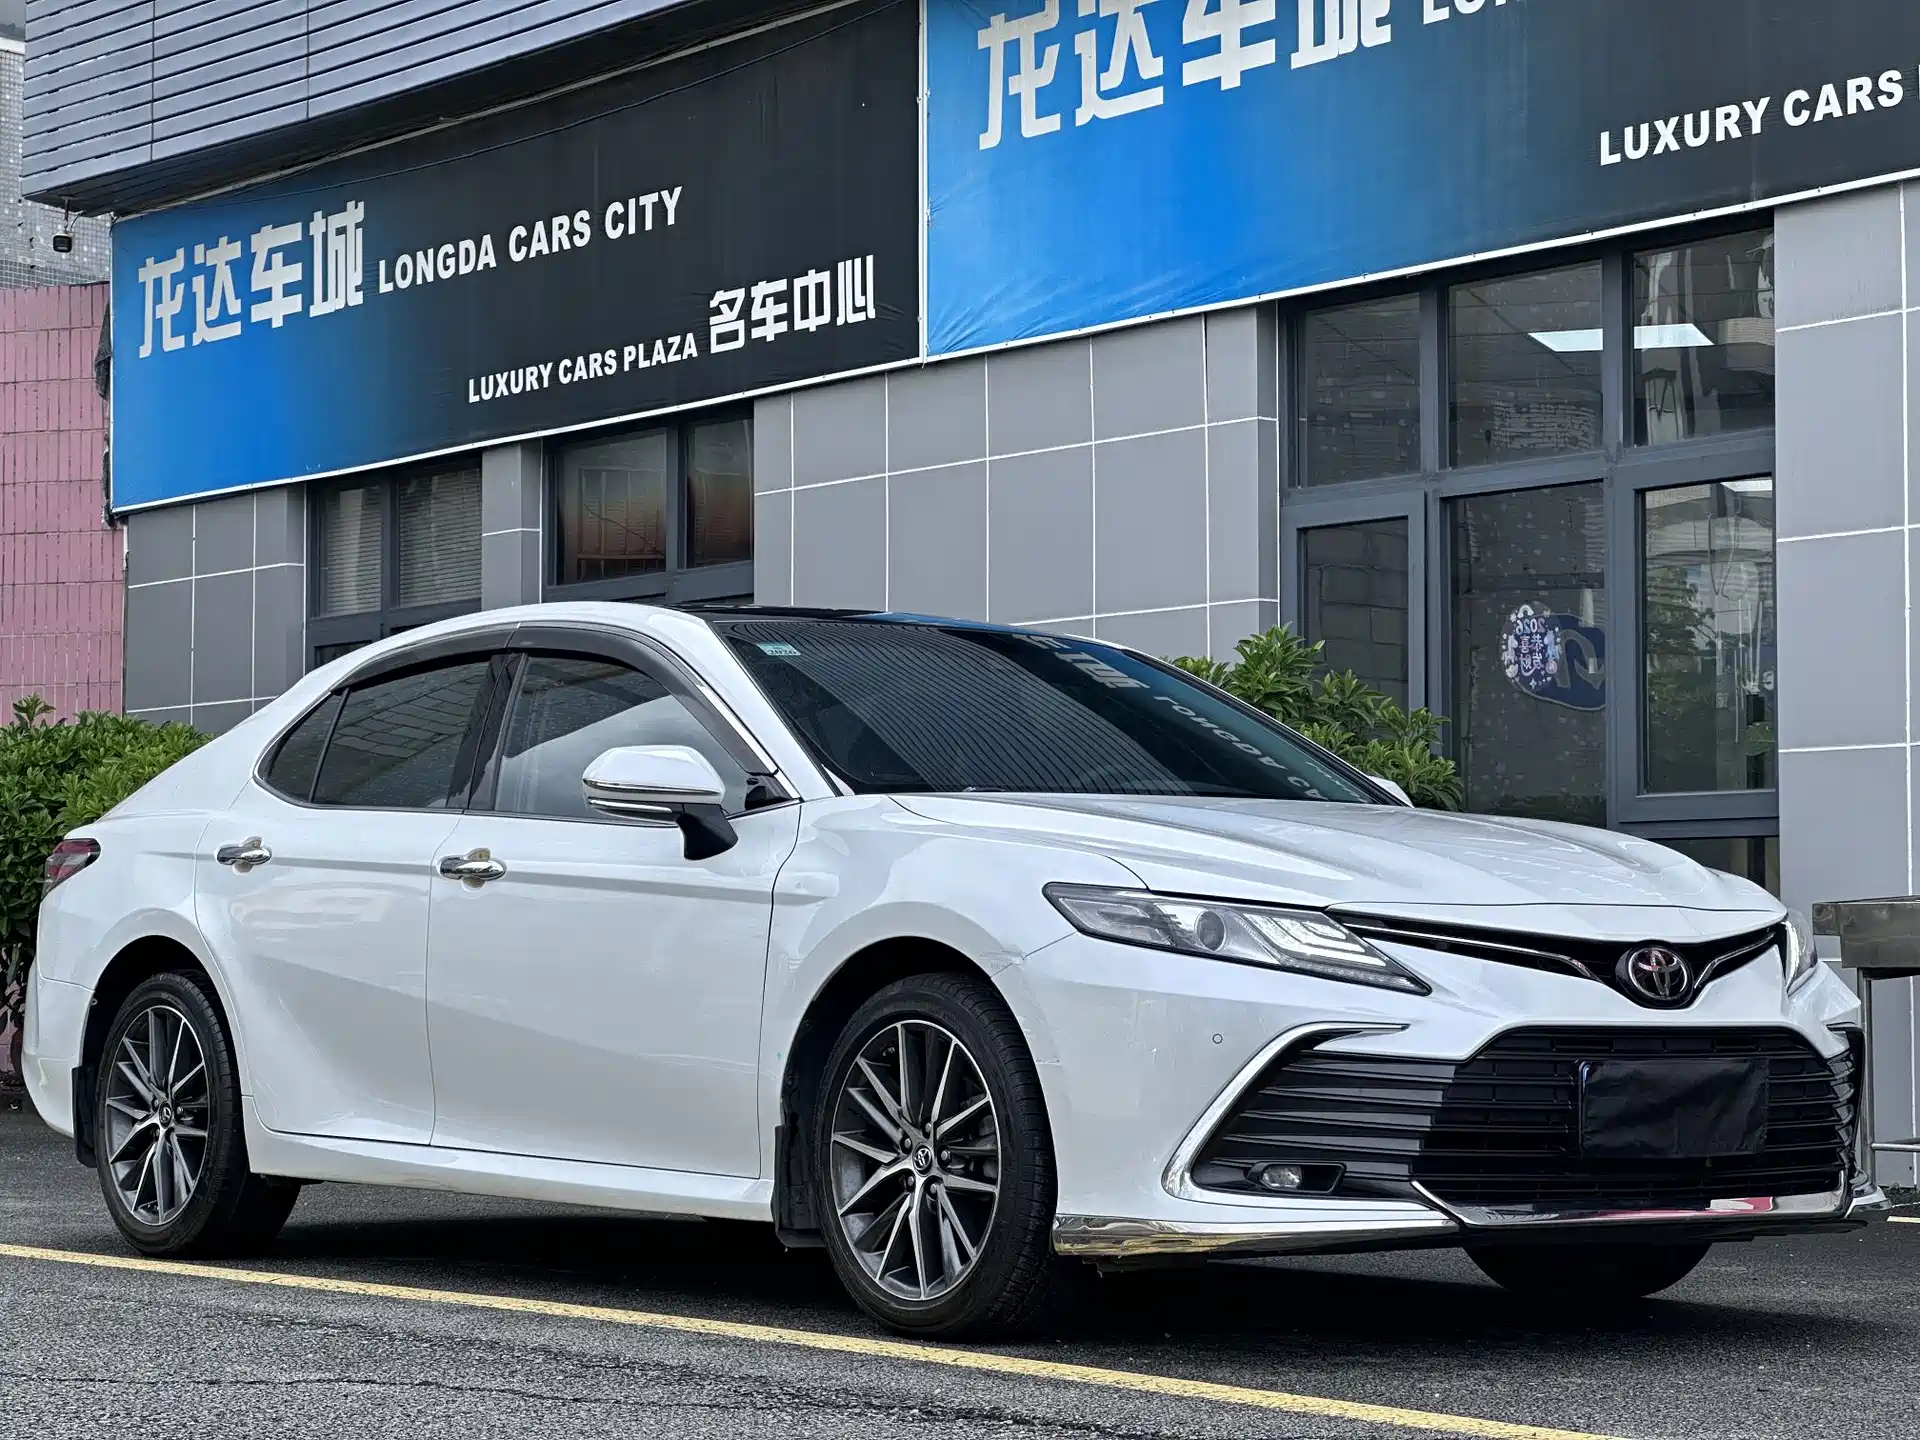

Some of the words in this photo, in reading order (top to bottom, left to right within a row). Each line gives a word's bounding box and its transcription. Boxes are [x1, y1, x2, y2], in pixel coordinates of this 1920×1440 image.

[1600, 96, 1771, 166] LUXURY
[1783, 69, 1904, 127] CARS
[138, 200, 366, 359] 龙达车城
[379, 233, 497, 294] LONGDA
[508, 209, 591, 262] CARS
[604, 186, 683, 240] CITY
[709, 254, 876, 354] 名车中心
[468, 361, 553, 404] LUXURY
[558, 349, 618, 388] CARS
[623, 332, 699, 372] PLAZA
